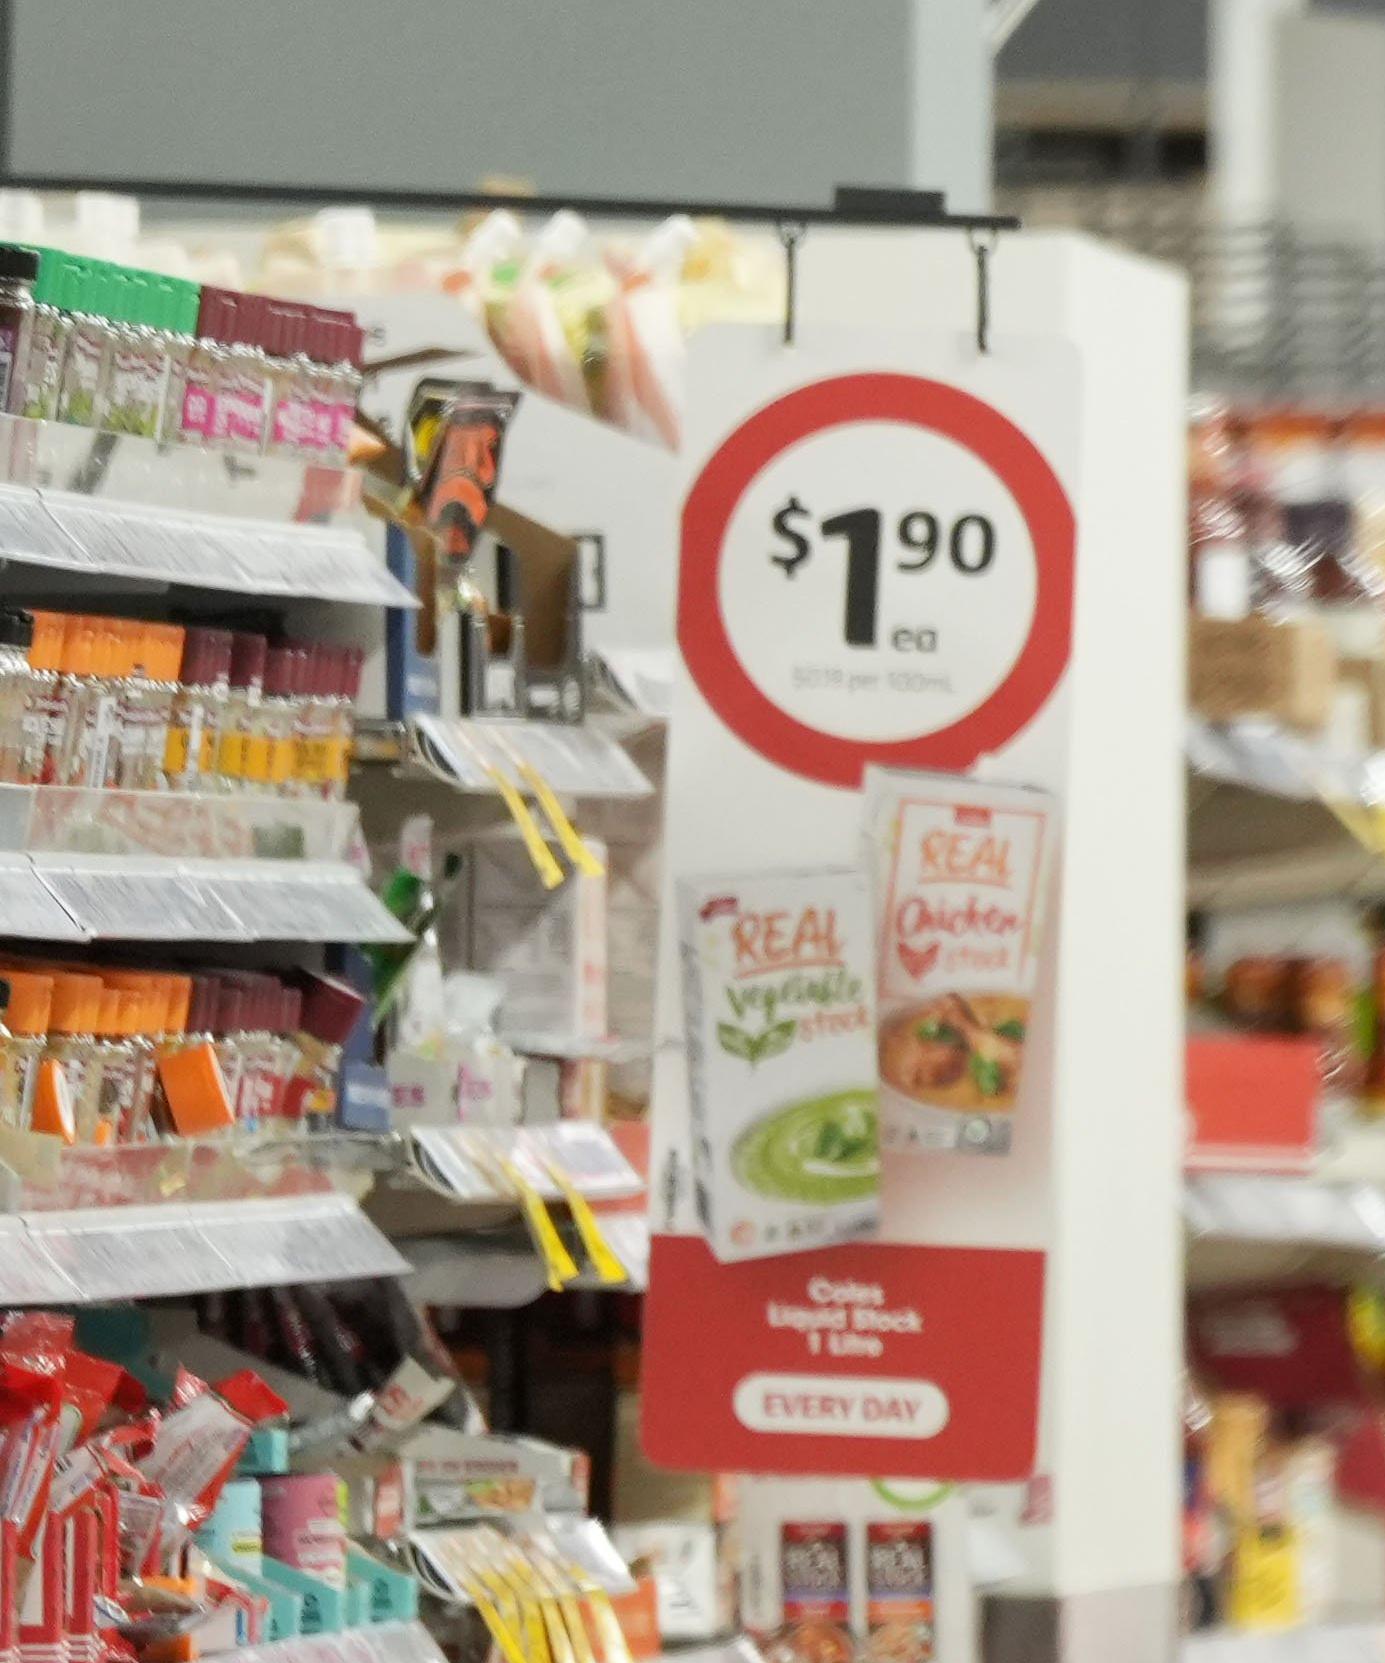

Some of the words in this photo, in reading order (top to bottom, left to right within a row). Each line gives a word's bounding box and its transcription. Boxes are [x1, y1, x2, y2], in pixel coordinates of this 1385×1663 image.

[919, 829, 1013, 877] REAL
[731, 905, 845, 961] REAL
[851, 1306, 924, 1333] Stock
[762, 1393, 852, 1421] EVERY
[862, 1394, 924, 1422] DAY
